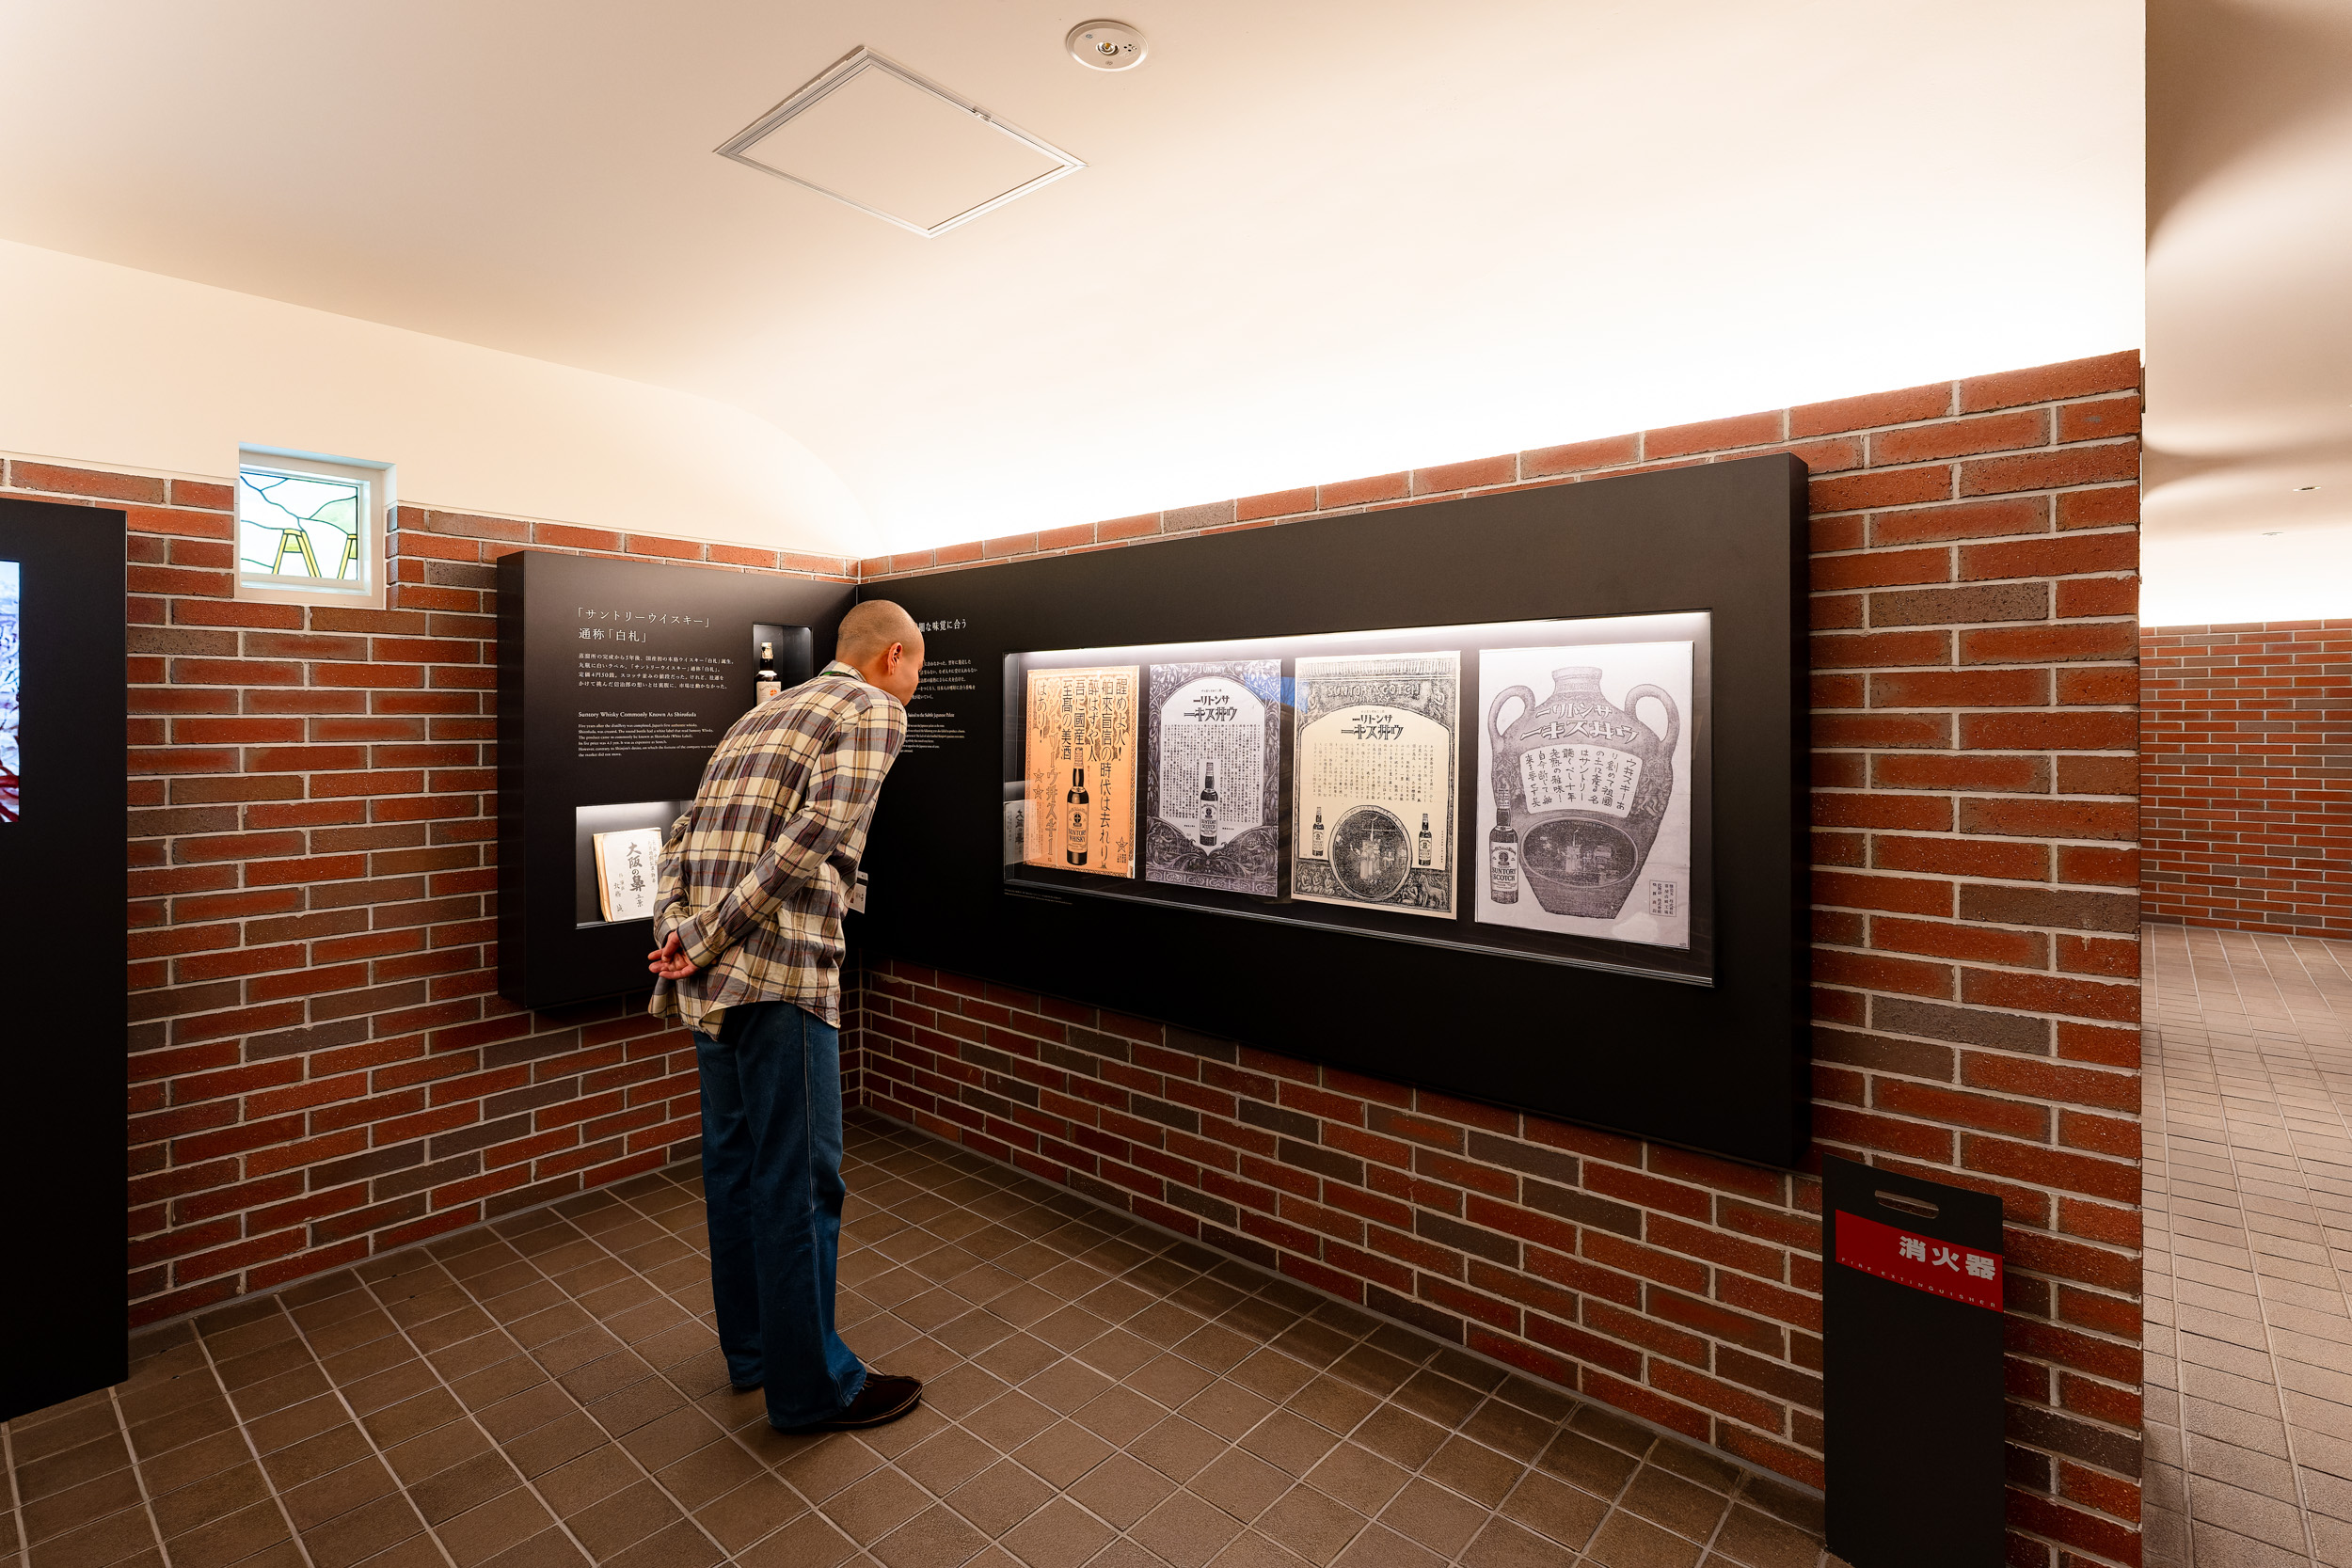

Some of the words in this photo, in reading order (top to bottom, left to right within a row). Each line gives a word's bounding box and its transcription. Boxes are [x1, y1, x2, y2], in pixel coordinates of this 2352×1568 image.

[578, 607, 710, 628] 「サントリーウイスキー」
[579, 627, 647, 643] 通称「白札」
[1037, 682, 1047, 743] はあり!
[1327, 685, 1374, 696] SUNTORY
[1375, 683, 1421, 696] SCOTCH
[1115, 679, 1128, 761] 醒めよ人!
[1579, 749, 1590, 801] はサントリー
[626, 842, 645, 892] 大阪の鼻
[1841, 1257, 1871, 1271] FIRE
[1881, 1271, 1995, 1308] EXTINGUISHER
[1899, 1236, 1996, 1281] 消火器
